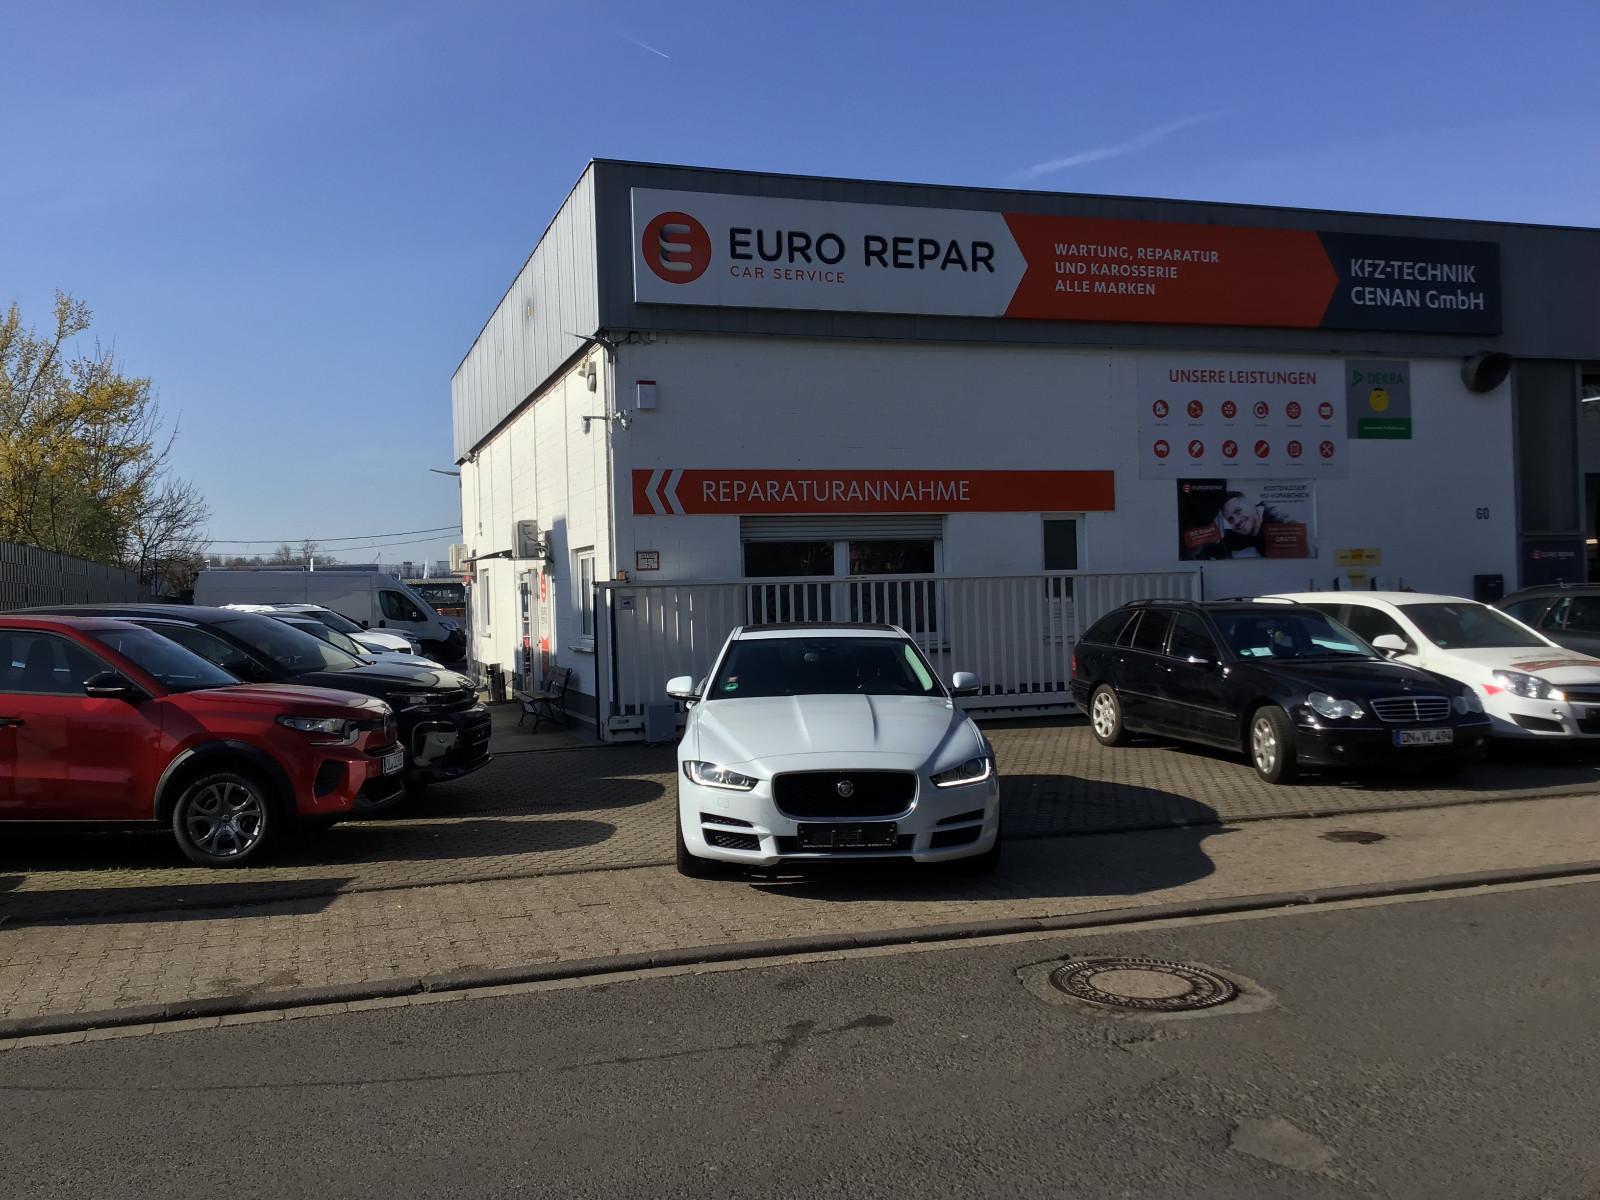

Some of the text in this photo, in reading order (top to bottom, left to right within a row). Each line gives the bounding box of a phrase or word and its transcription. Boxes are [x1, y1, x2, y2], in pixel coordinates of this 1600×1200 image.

[729, 227, 995, 273] EURO REPAR
[1054, 242, 1220, 264] WARTUNG, REPARATUR
[729, 265, 845, 284] CAR SERVICE
[1054, 261, 1178, 280] UND KAROSSERIE
[1350, 258, 1477, 284] KFZ-TECHNIK
[1054, 279, 1156, 296] ALLE MARKEN
[1350, 286, 1485, 311] CENAN GmbH
[1168, 369, 1317, 385] UNSERE LEISTUNGEN
[1366, 371, 1405, 385] DEKRA
[702, 479, 970, 502] REPARATURANNAHME
